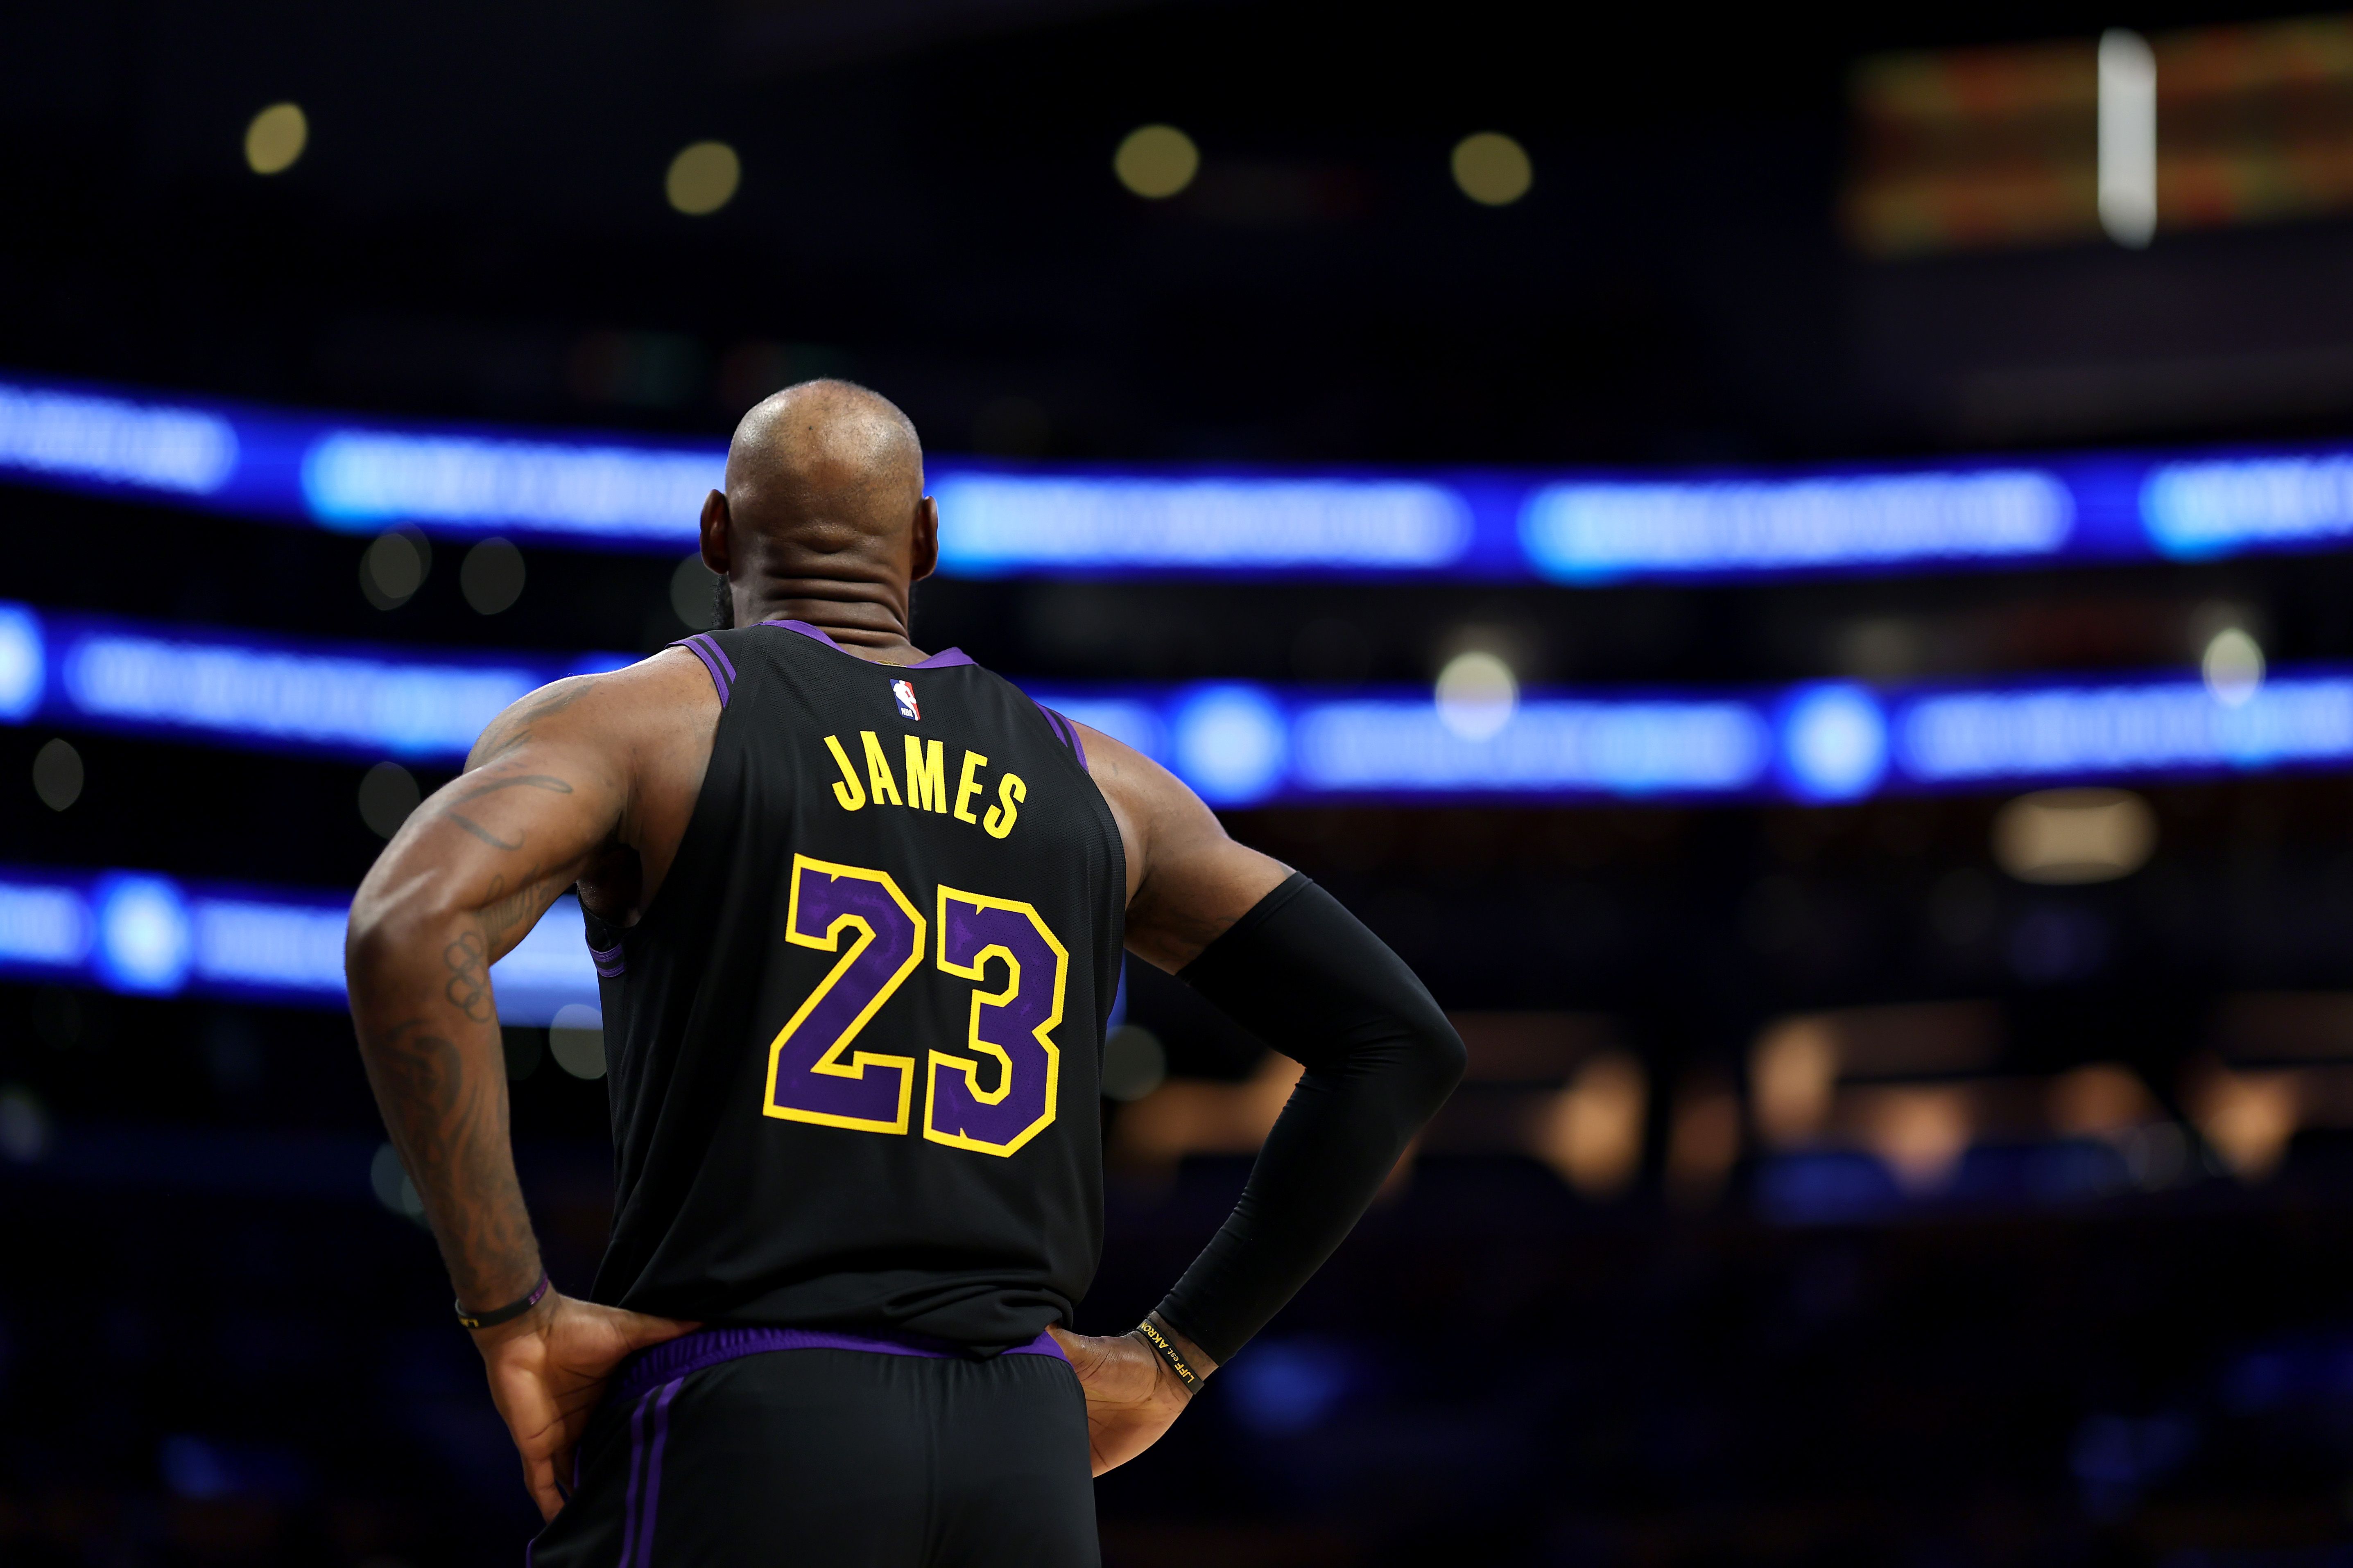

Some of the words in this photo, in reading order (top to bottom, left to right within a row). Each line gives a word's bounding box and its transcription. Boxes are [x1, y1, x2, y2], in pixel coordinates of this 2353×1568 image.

[901, 707, 913, 717] NBA
[824, 731, 1027, 839] JAMES
[762, 853, 1069, 1158] 23
[1140, 1322, 1169, 1349] AKRON
[1167, 1348, 1179, 1361] est.
[1174, 1363, 1195, 1383] LJFF
